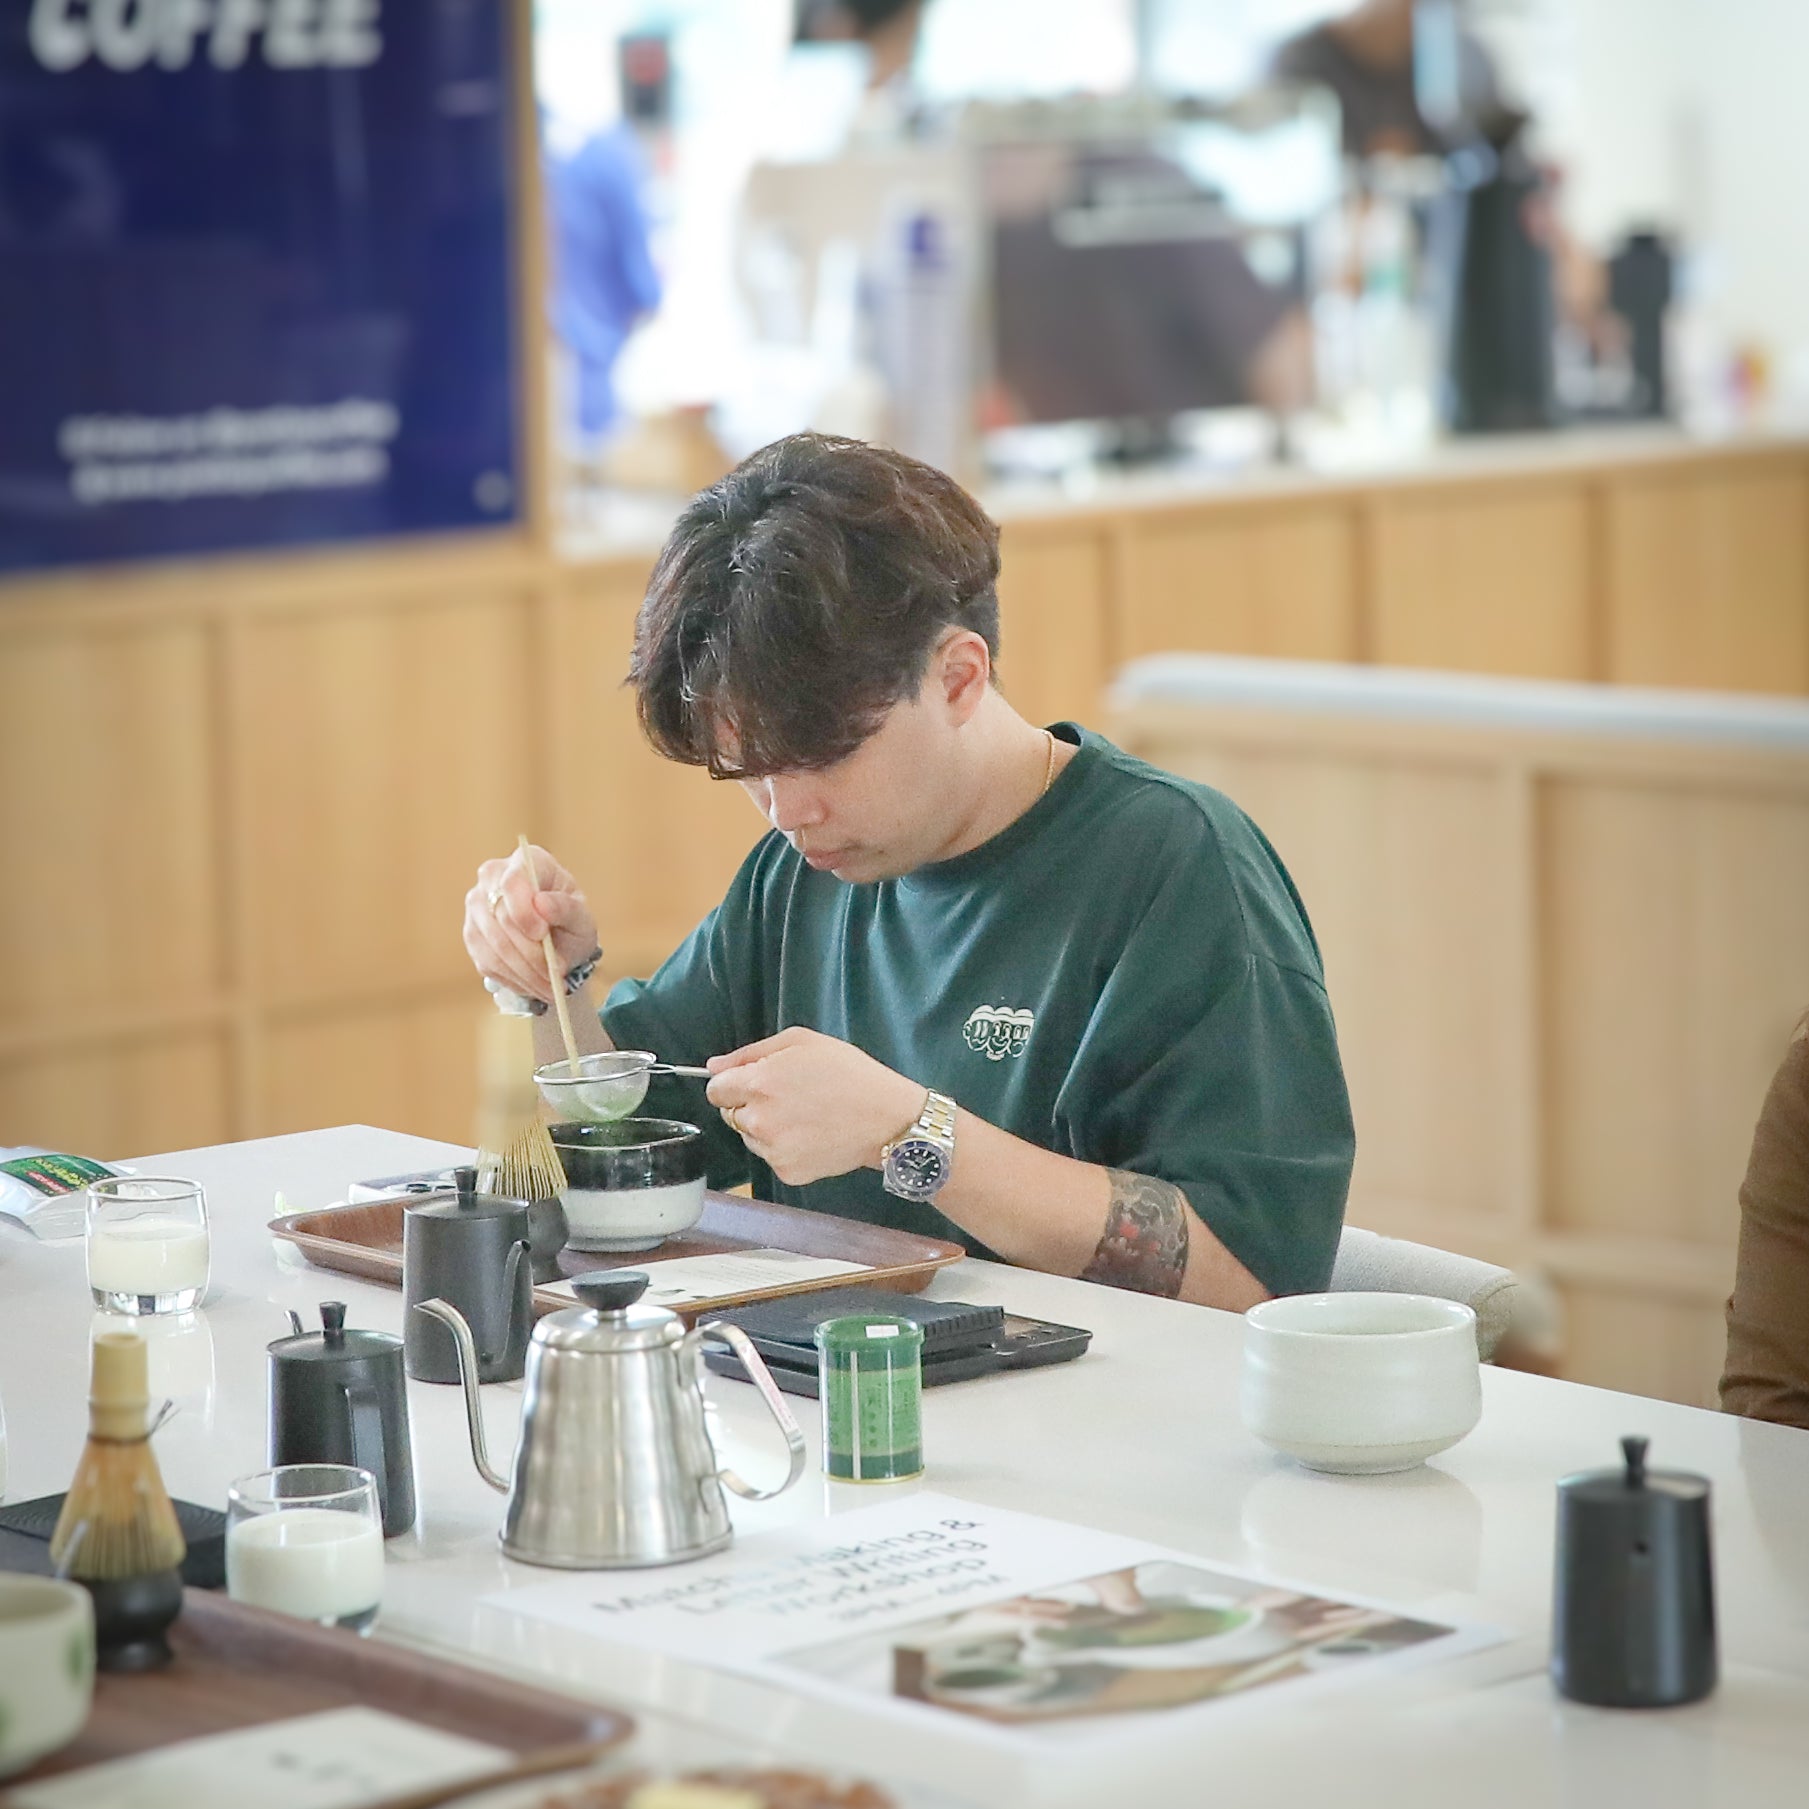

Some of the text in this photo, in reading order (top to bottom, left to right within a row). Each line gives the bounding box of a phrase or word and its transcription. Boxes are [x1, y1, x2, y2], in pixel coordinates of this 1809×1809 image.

[29, 0, 382, 72] COFFEE
[776, 1530, 946, 1570] Making
[939, 1519, 985, 1531] &
[812, 1539, 988, 1578] Writing
[750, 1558, 987, 1616] Workshop
